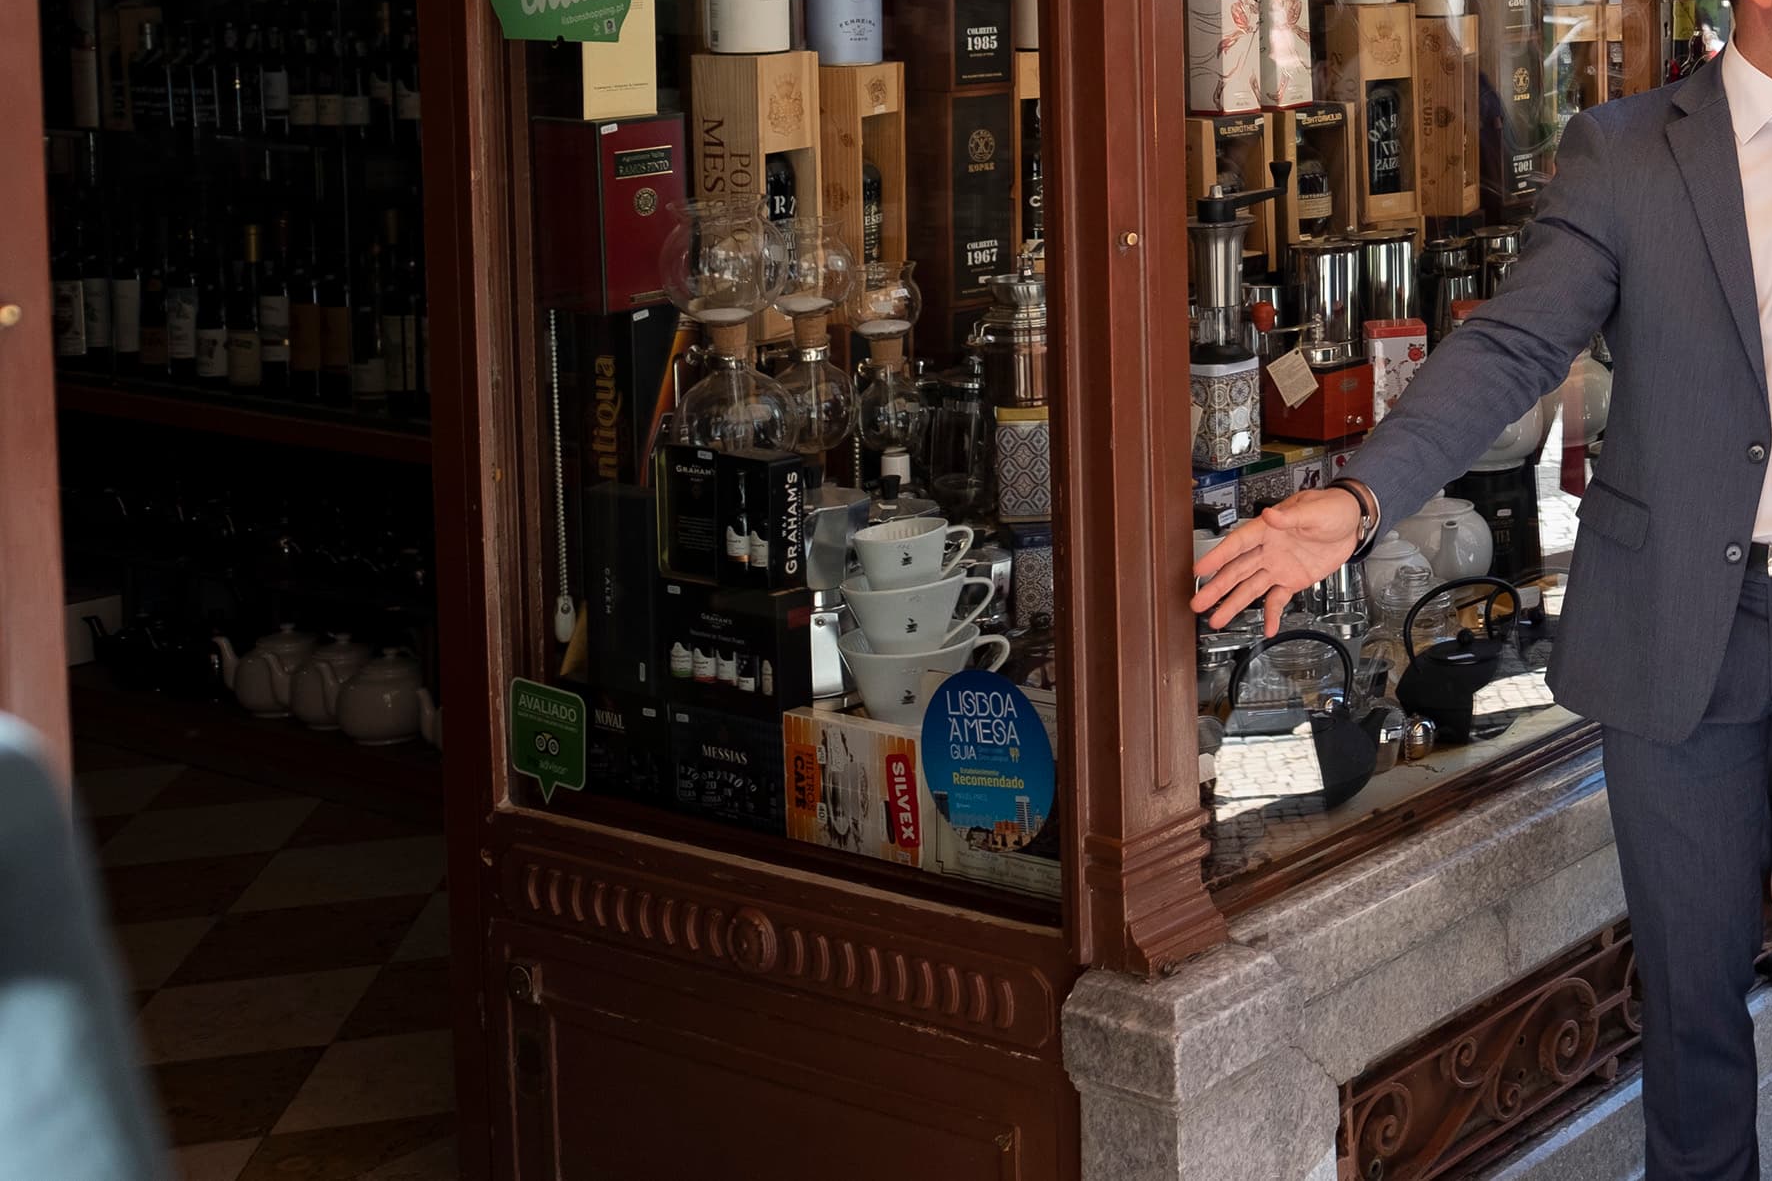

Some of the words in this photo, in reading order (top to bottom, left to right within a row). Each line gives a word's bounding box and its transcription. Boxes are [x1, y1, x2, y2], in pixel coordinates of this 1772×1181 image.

[967, 27, 998, 35] COLHEITA
[967, 35, 998, 51] 1985
[967, 240, 998, 250] COLHEITA
[967, 249, 998, 266] 1967
[785, 471, 798, 575] GRAHAM'S
[518, 694, 577, 723] AVALIADO
[946, 690, 1018, 718] LISBOA
[594, 708, 625, 729] NOVAL
[964, 718, 1020, 745] MESA
[702, 743, 748, 766] MESSIAS
[950, 744, 977, 760] GUIA
[805, 752, 816, 812] FILTROS
[952, 772, 1025, 789] Recomendado
[892, 761, 916, 840] SILVEX
